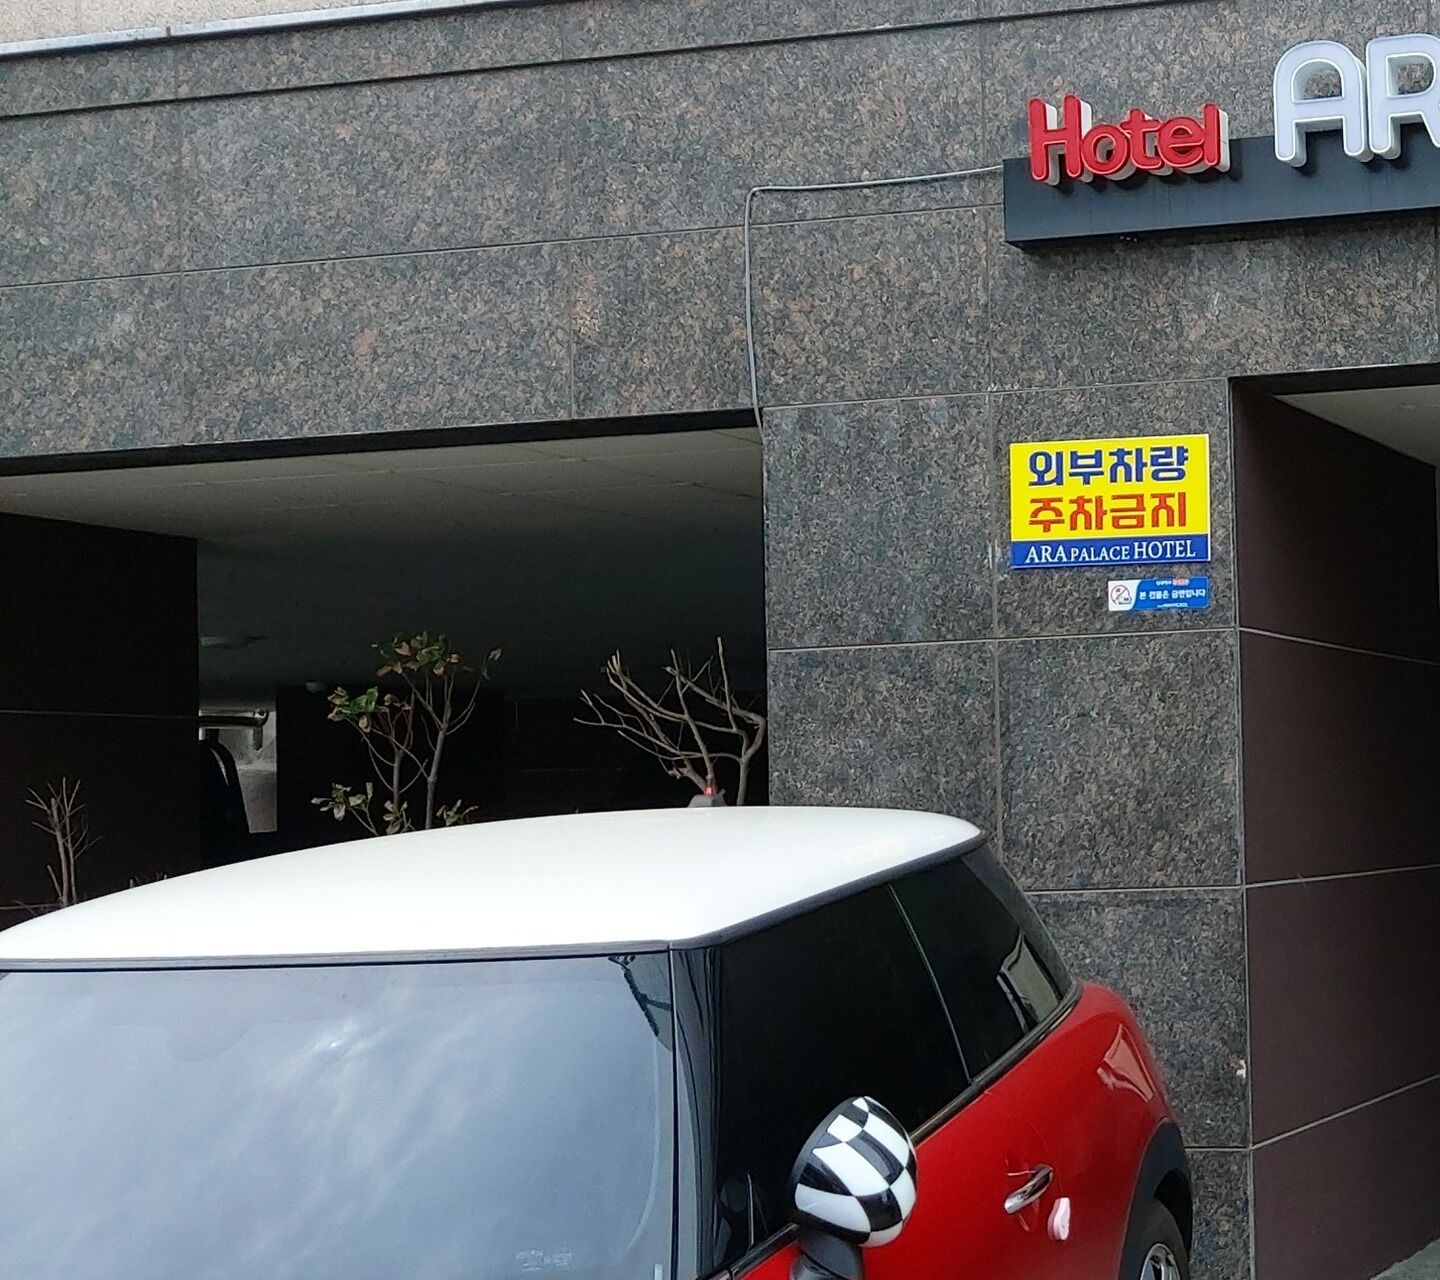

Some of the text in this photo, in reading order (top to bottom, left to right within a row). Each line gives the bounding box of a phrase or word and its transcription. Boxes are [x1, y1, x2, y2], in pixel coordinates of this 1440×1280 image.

[1028, 94, 1225, 183] Hotel
[1028, 445, 1189, 487] 외부차량
[1028, 491, 1187, 533] 주차금지
[1025, 540, 1196, 563] ARA PALACE HOTEL
